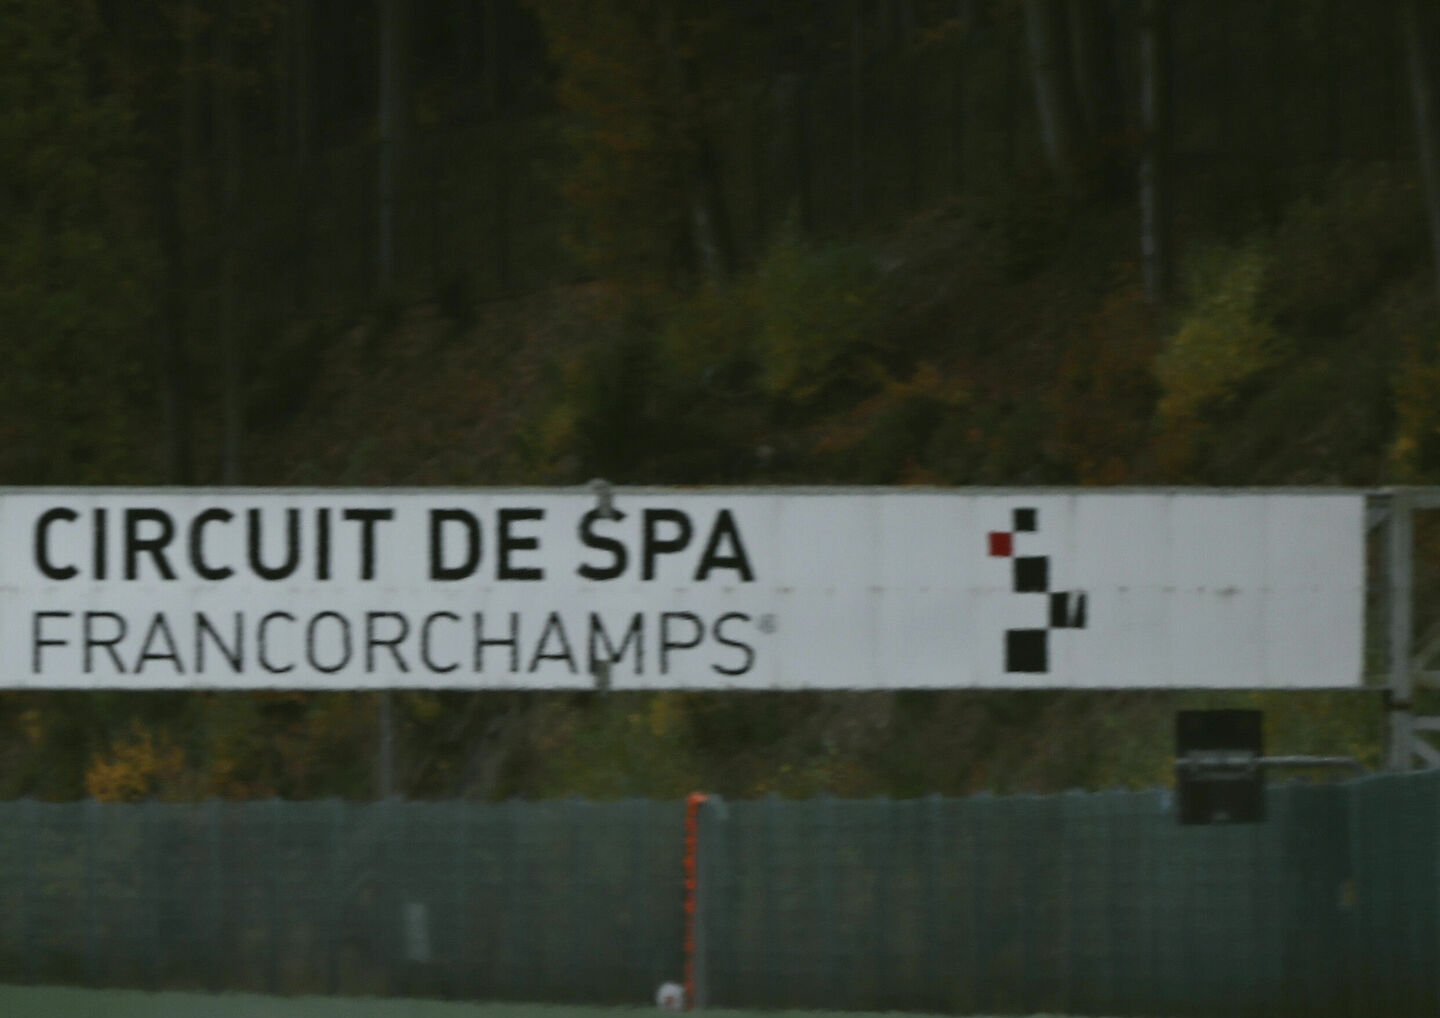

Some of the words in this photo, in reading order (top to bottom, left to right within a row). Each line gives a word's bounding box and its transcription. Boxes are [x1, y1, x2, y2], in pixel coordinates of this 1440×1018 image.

[34, 507, 395, 582] CIRCUIT
[428, 507, 547, 581] DE
[576, 508, 756, 582] SPA
